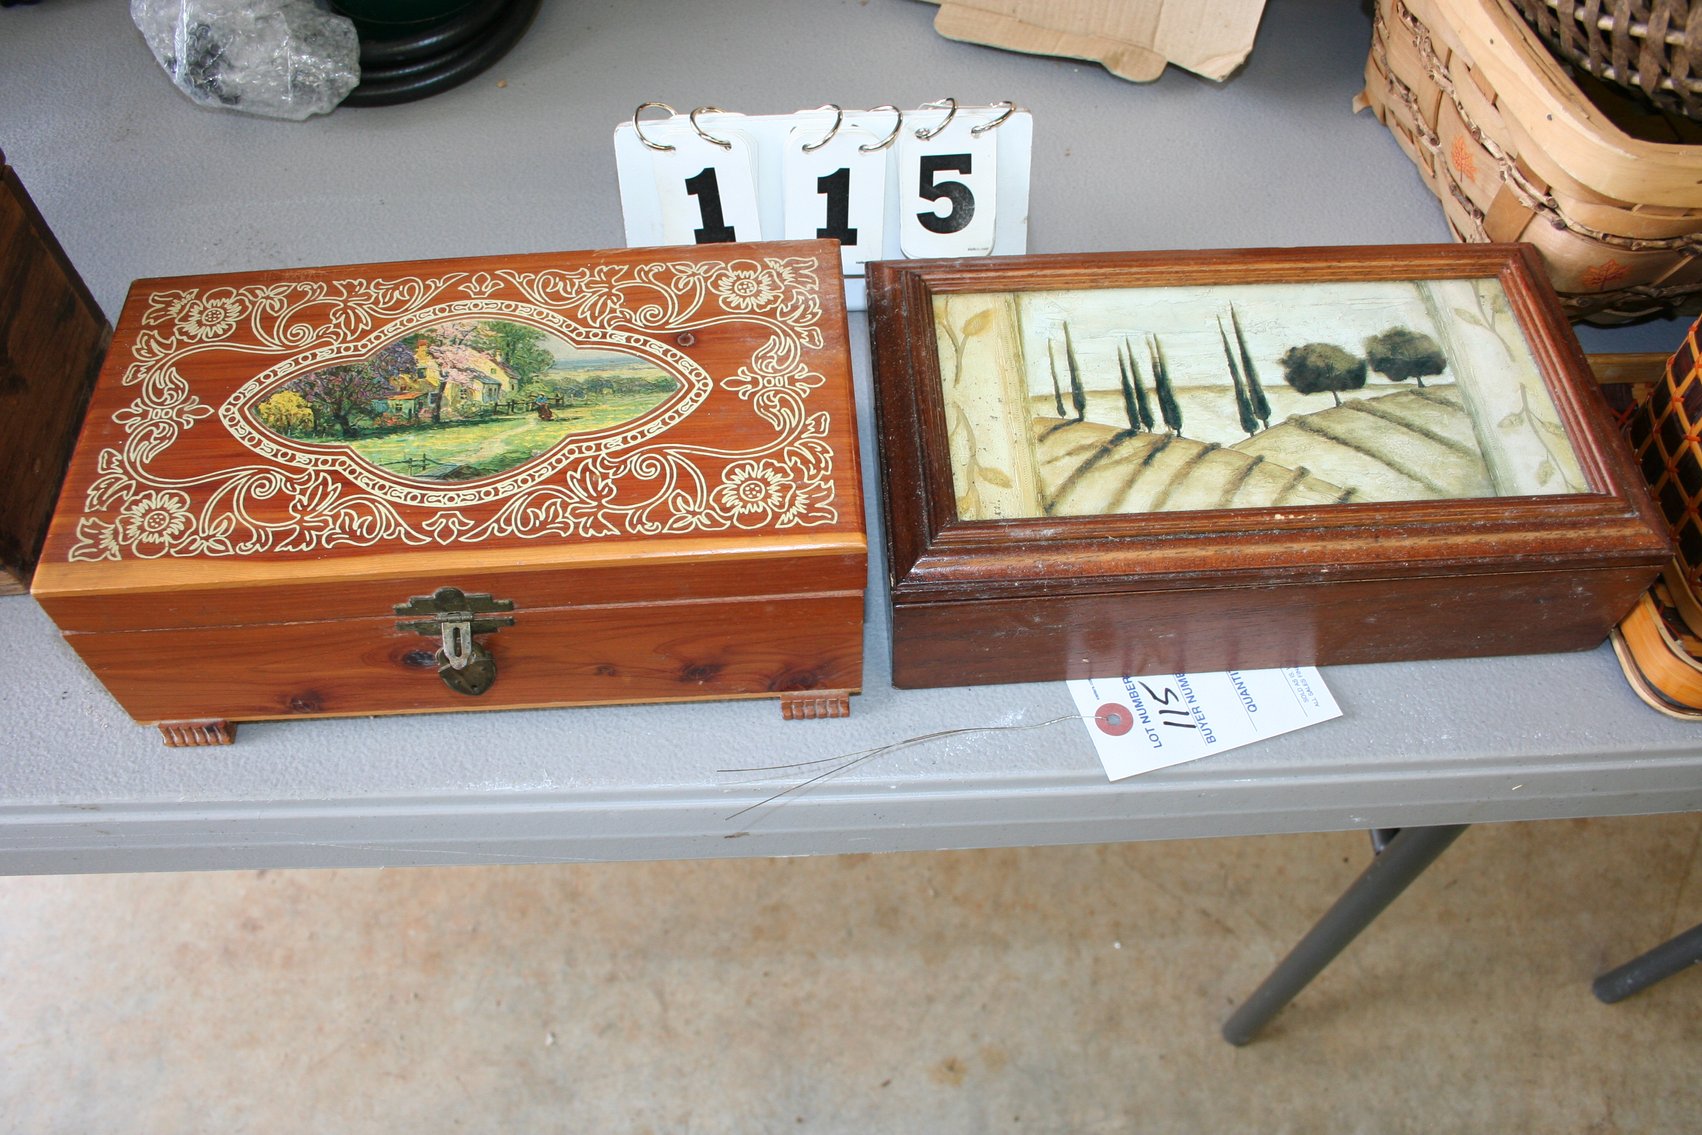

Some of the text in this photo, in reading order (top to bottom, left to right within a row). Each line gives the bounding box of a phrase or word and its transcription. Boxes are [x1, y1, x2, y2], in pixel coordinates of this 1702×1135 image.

[1122, 674, 1163, 749] LOT NUMBER
[1137, 680, 1197, 729] 115
[1228, 669, 1258, 712] QUANTI
[1191, 705, 1217, 744] BUYER
